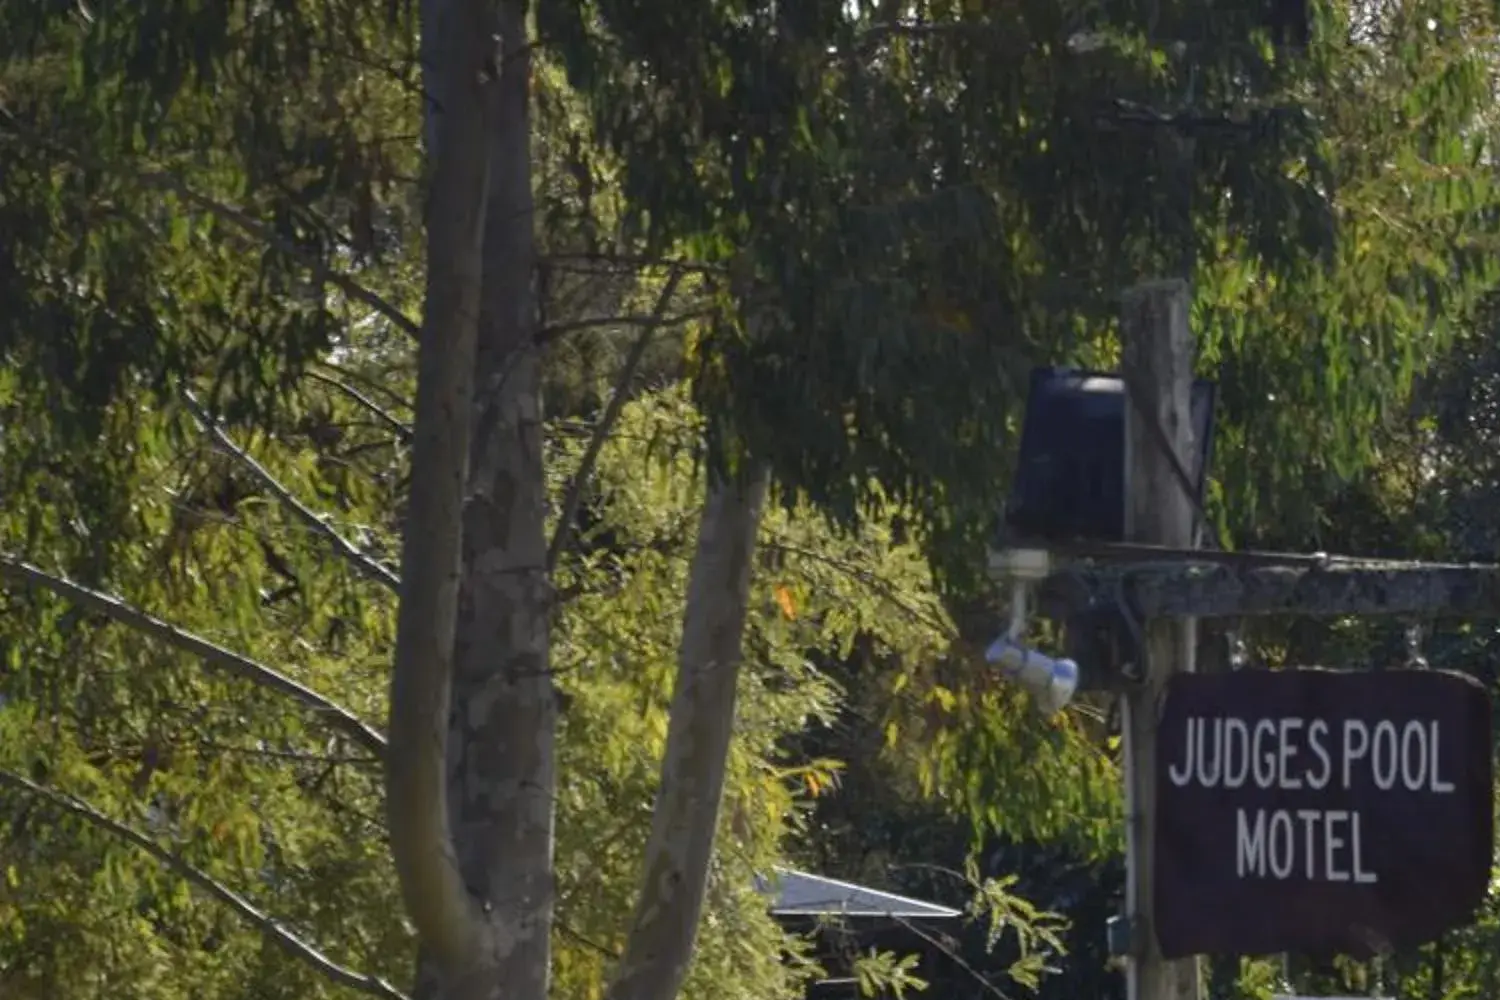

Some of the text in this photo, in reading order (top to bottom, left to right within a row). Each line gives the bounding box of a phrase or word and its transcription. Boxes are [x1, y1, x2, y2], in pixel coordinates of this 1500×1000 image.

[1169, 717, 1455, 792] JUDGES POOL
[1236, 808, 1378, 883] MOTEL
